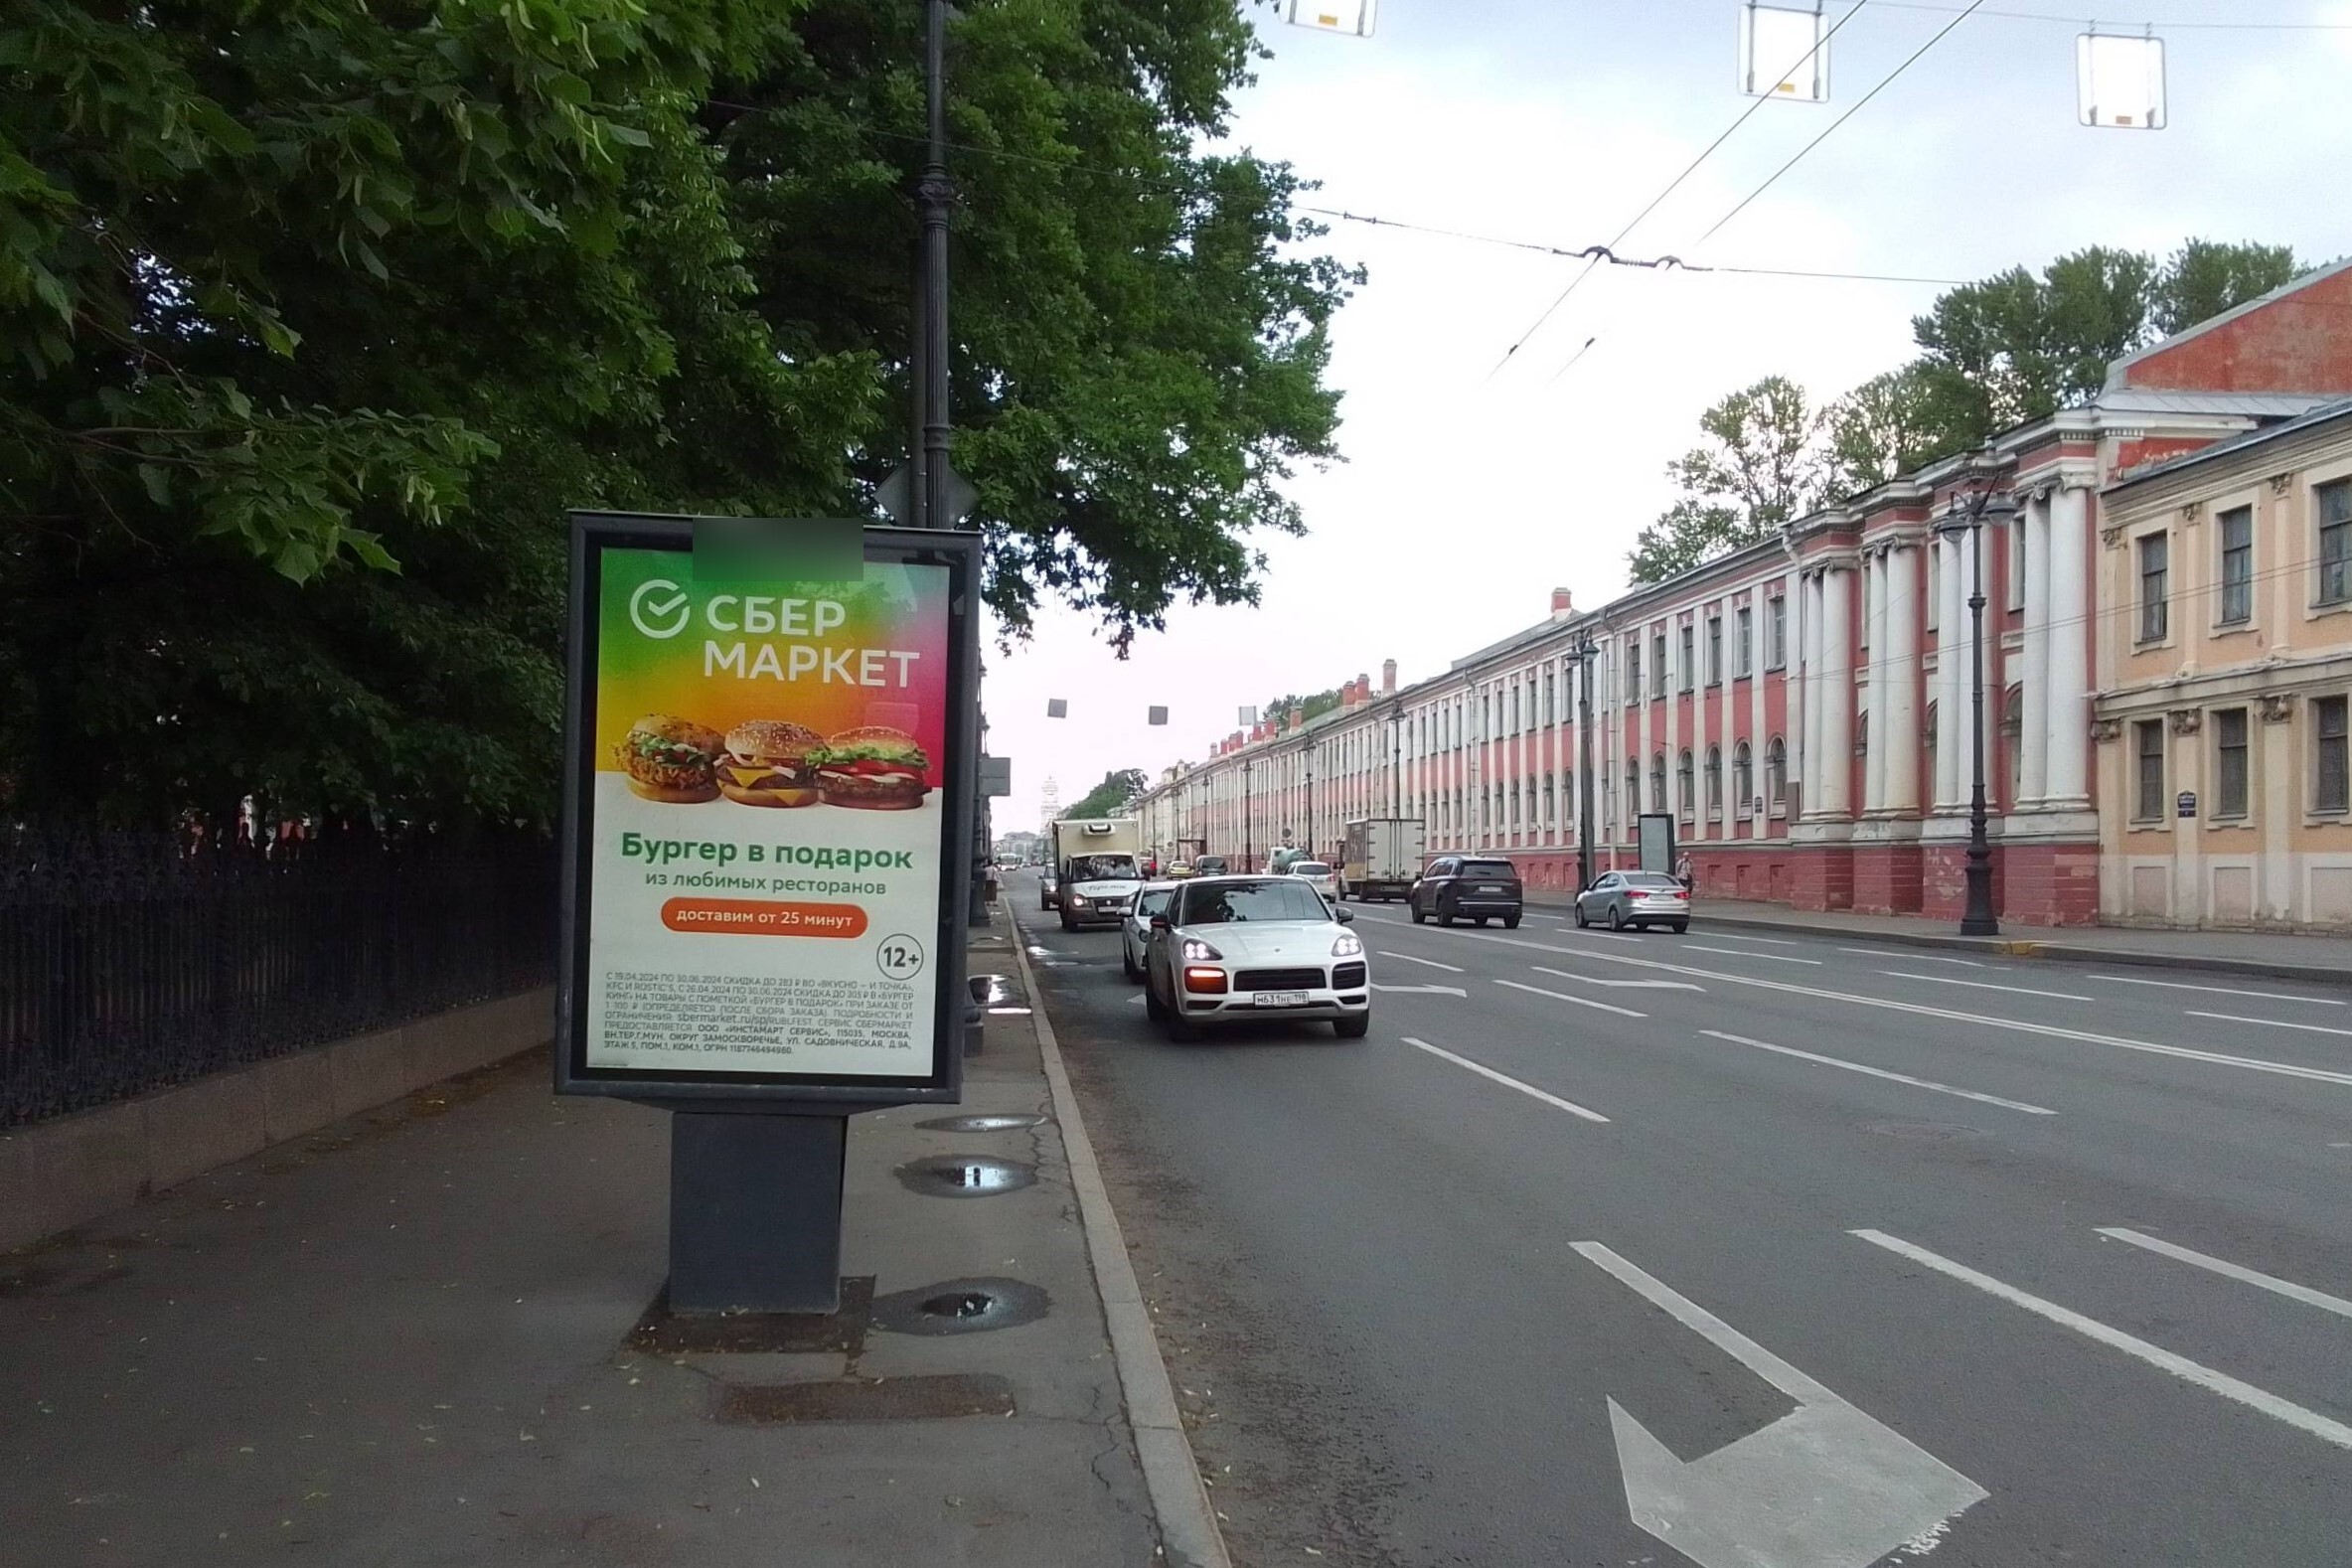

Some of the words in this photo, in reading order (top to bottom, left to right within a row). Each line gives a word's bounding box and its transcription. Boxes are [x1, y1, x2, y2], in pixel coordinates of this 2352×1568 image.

[706, 595, 846, 637] СБЕР
[705, 640, 920, 689] МАРКЕТ
[621, 832, 737, 867] Бургер
[747, 844, 765, 862] в
[775, 845, 913, 873] подарок
[645, 872, 668, 886] из
[672, 870, 767, 890] любимых
[772, 878, 887, 896] ресторанов
[676, 910, 753, 923] доставим
[758, 913, 777, 923] от
[781, 911, 800, 924] 25
[804, 915, 853, 929] минут
[883, 946, 920, 968] 12+
[723, 976, 761, 986] СКИДКА
[762, 978, 777, 987] ДО
[832, 990, 846, 999] ДО
[846, 1000, 864, 1009] ПРИ
[698, 1023, 719, 1032] ООО
[856, 1019, 912, 1030] СБЕРМАРКЕТ
[669, 1032, 700, 1041] ОКРУГ
